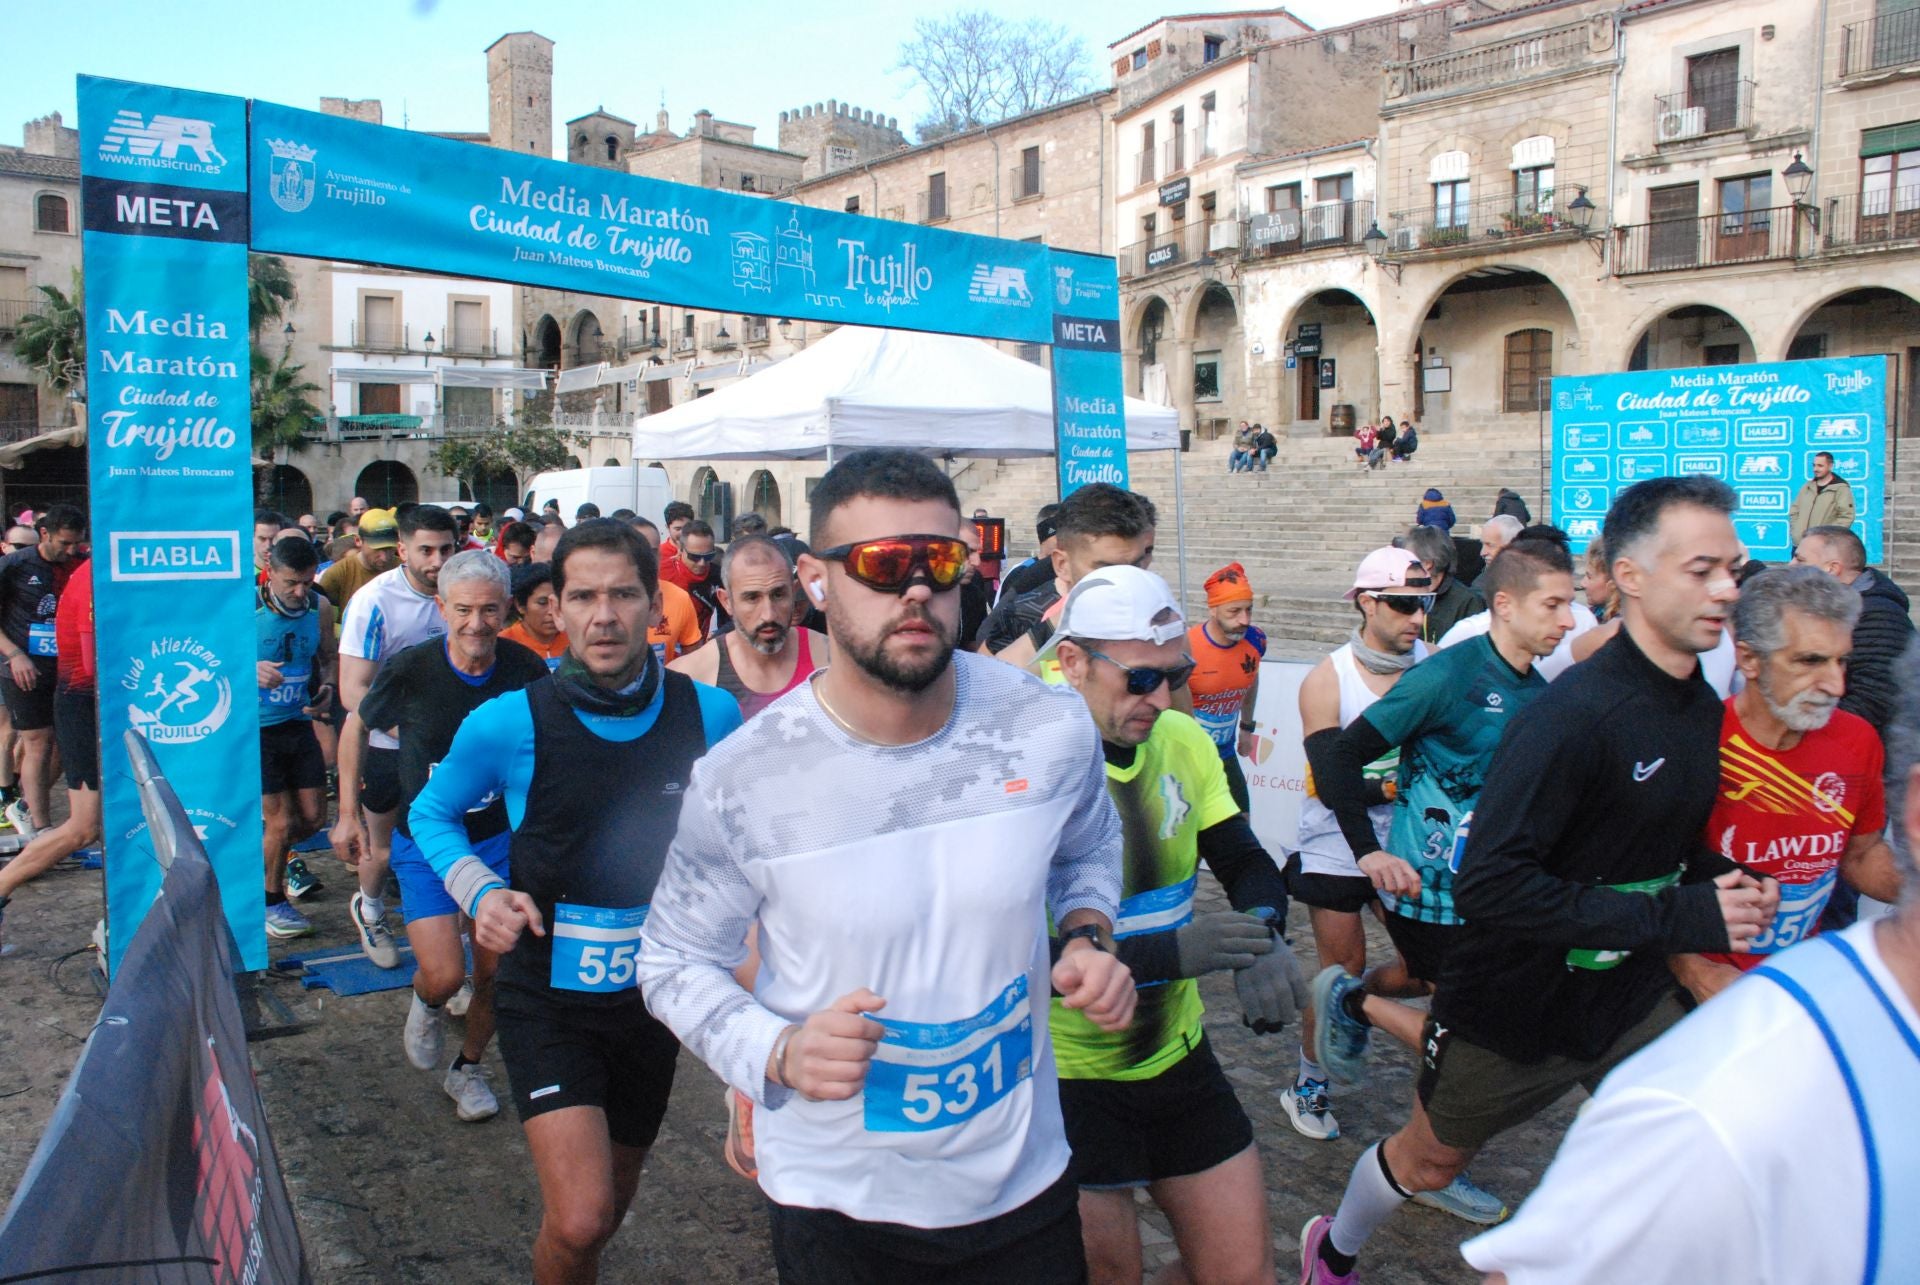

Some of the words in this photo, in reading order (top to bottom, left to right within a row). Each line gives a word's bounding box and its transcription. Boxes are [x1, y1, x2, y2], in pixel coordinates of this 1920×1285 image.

[98, 151, 221, 175] www.musicrun.es
[325, 169, 398, 192] Ayuntamiento
[399, 186, 411, 194] de
[324, 183, 386, 206] Trujillo
[116, 194, 220, 231] META
[500, 176, 592, 218] Media
[600, 193, 711, 236] Maratón
[469, 204, 563, 245] Ciudad
[567, 223, 602, 250] de
[605, 225, 693, 269] Trujillo
[512, 246, 545, 262] Juan
[548, 252, 594, 270] Mateos
[595, 259, 651, 279] Broncano
[837, 238, 933, 301] Trujillo
[864, 287, 875, 305] te
[1074, 287, 1101, 299] Trujillo
[105, 308, 229, 340] Media
[1061, 322, 1107, 343] META
[100, 349, 239, 378] Maratón
[1670, 373, 1714, 388] Media
[1718, 370, 1779, 386] Maratón
[1824, 369, 1873, 391] Trujillo
[119, 385, 191, 407] Ciudad
[194, 391, 219, 408] de
[1064, 397, 1116, 415] Media
[1616, 388, 1690, 412] Ciudad
[1692, 390, 1722, 406] de
[1727, 384, 1811, 413] Trujillo
[101, 409, 236, 461] Trujillo
[1063, 422, 1122, 440] Maratón
[1748, 427, 1780, 436] HABLA
[1071, 444, 1101, 458] Ciudad
[1101, 446, 1113, 458] de
[109, 465, 137, 478] Juan
[139, 466, 179, 477] Mateos
[182, 467, 235, 478] Broncano
[1684, 461, 1715, 470] HABLA
[1745, 496, 1778, 505] HABLA
[130, 546, 222, 567] HABLA
[120, 656, 146, 691] Club
[150, 634, 222, 668] Atletismo
[137, 721, 213, 740] TRUJILLO
[1253, 774, 1266, 787] DE
[196, 808, 214, 818] San
[902, 1041, 1003, 1123] 531
